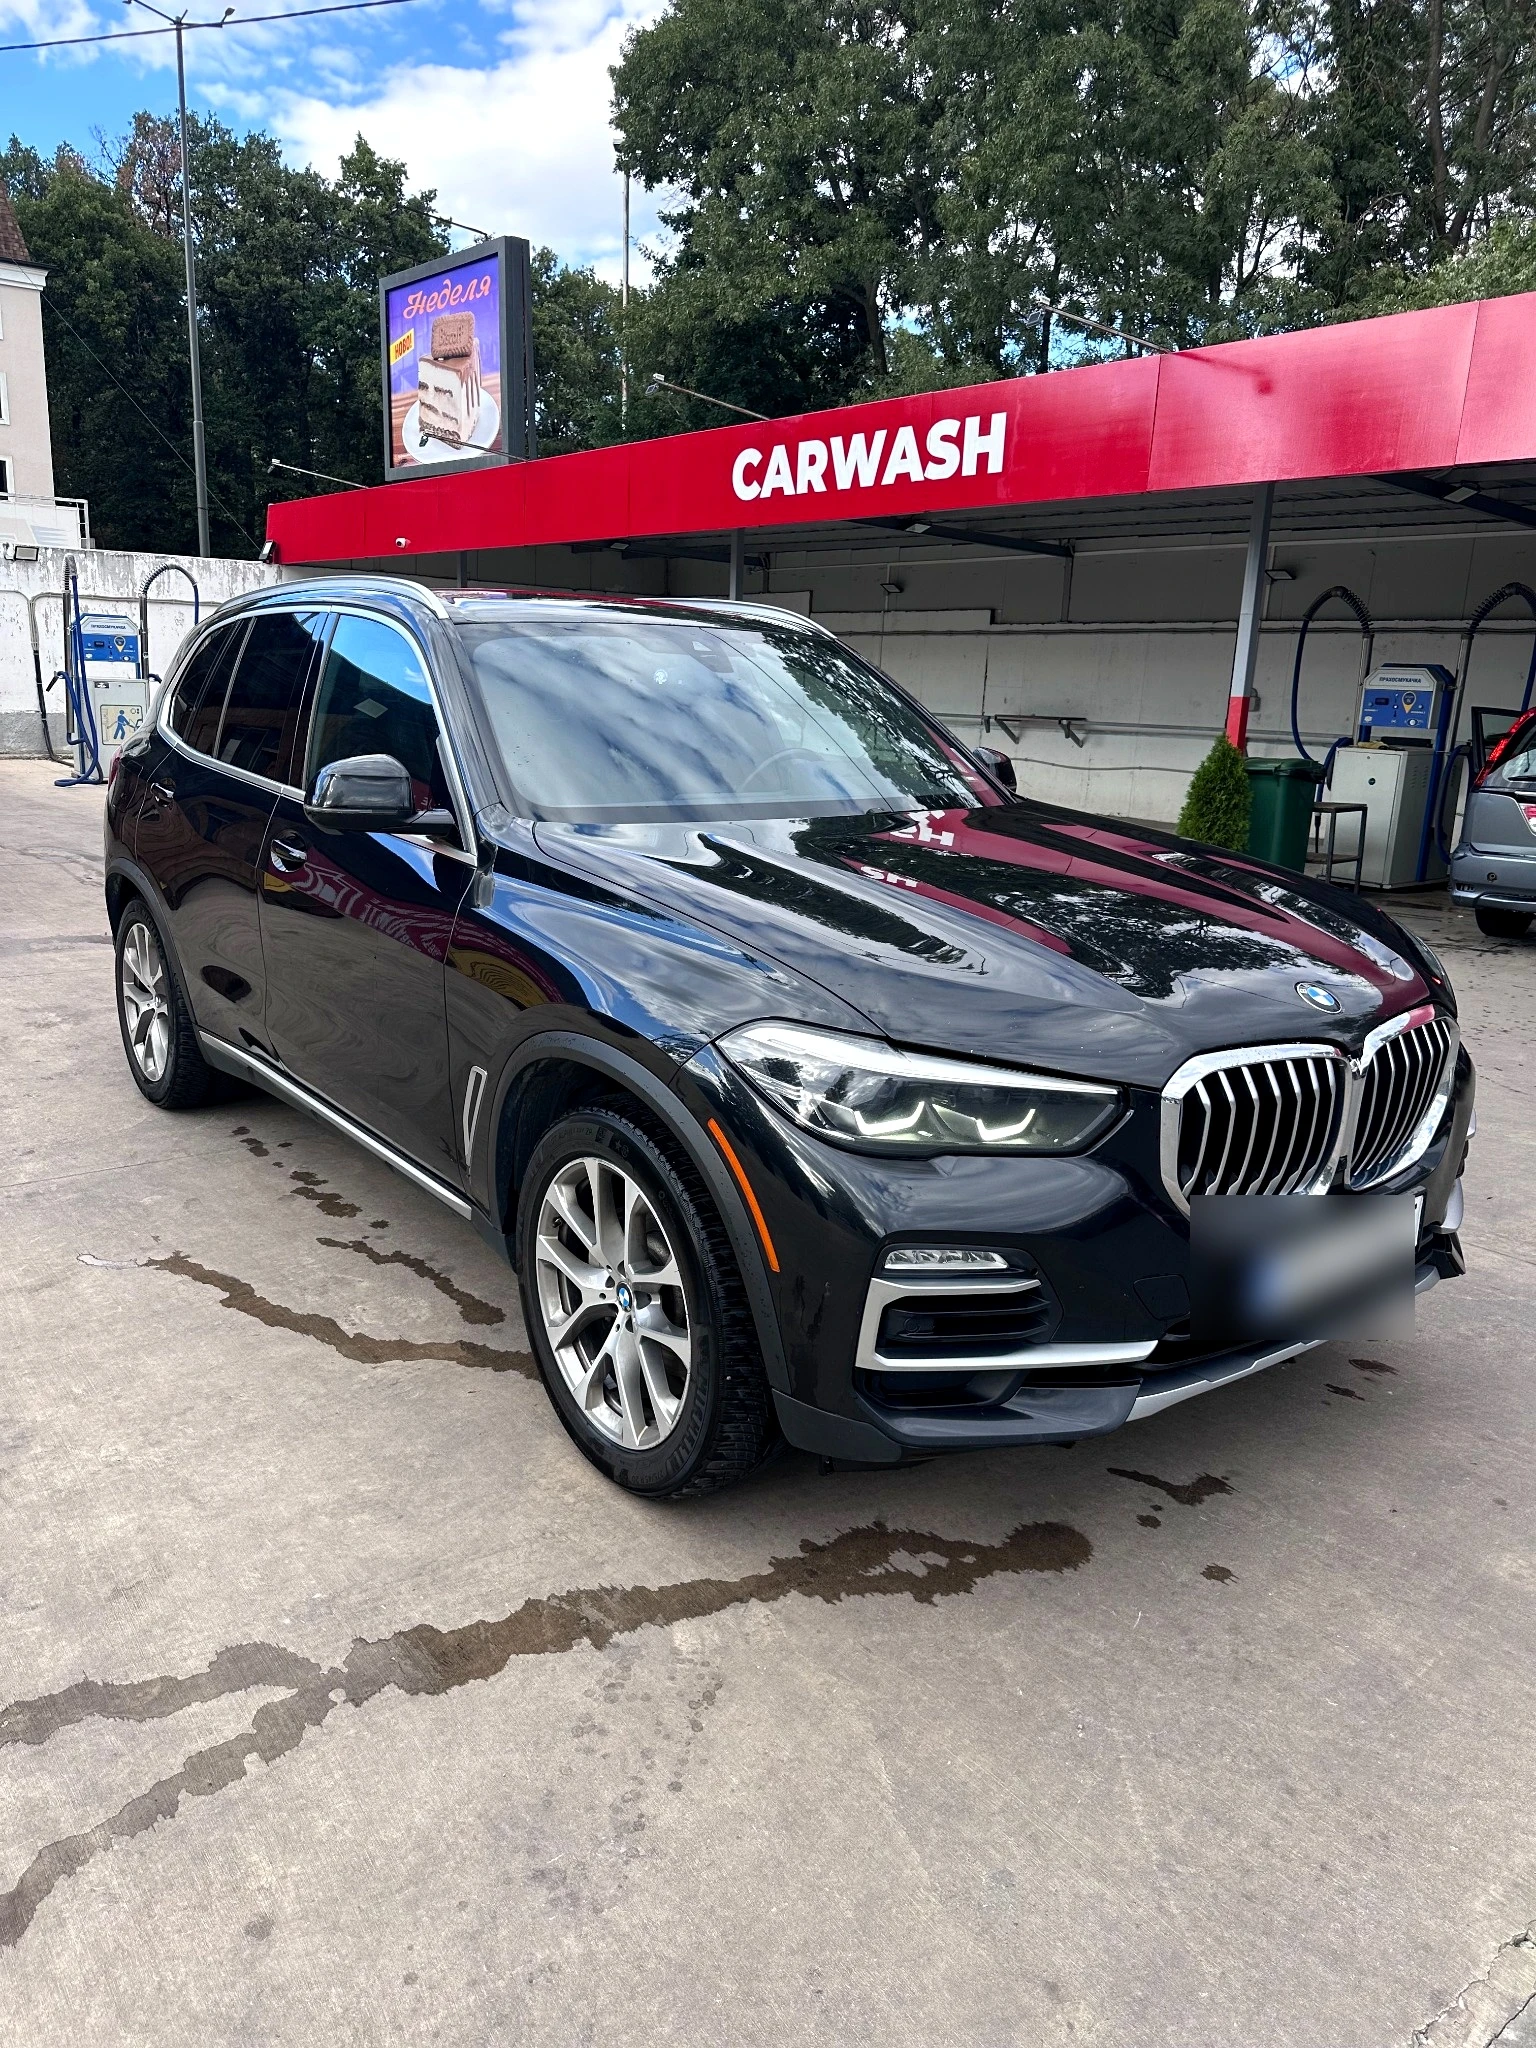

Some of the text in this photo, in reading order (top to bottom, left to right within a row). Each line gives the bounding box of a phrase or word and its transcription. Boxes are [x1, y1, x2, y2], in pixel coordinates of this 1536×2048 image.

[403, 275, 491, 319] Неделя
[394, 333, 412, 360] НОВО!
[732, 412, 1007, 501] CARWASH
